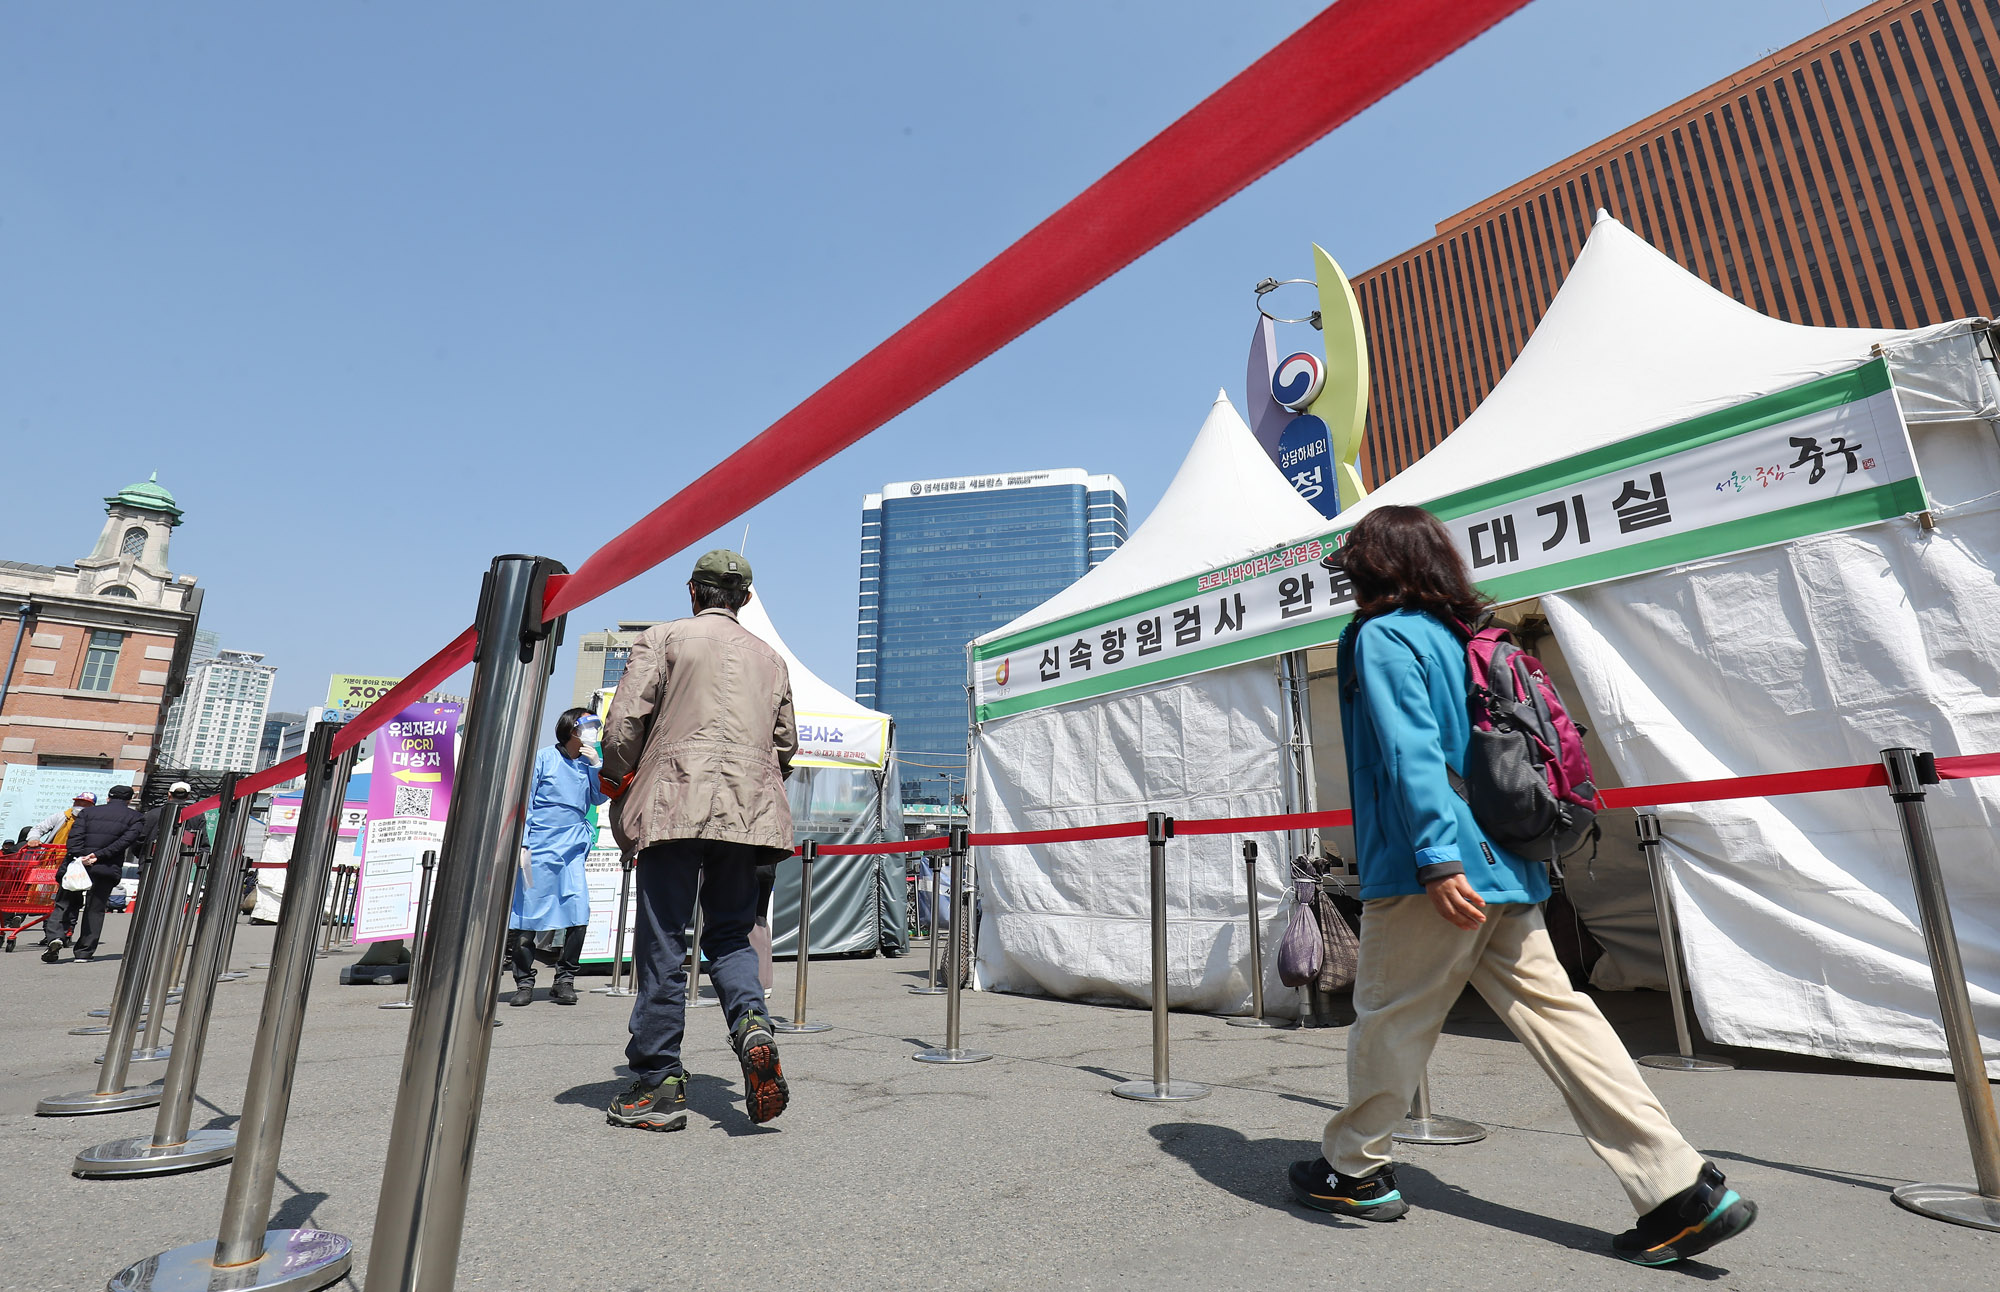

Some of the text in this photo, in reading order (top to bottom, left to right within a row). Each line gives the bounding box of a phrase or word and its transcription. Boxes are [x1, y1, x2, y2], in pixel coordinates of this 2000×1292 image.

[1281, 438, 1327, 469] 상담하세요!
[1715, 470, 1752, 493] 서울의
[1755, 464, 1788, 488] 중심
[1789, 436, 1862, 485] 중구
[1039, 592, 1246, 682] 신속항원검사
[1467, 471, 1672, 569] 대기실
[1198, 541, 1323, 592] 코로나바이러스감염증
[388, 721, 448, 737] 유전자검사
[798, 724, 844, 743] 검사소
[401, 738, 434, 751] (PCR)
[391, 751, 441, 768] 대상자
